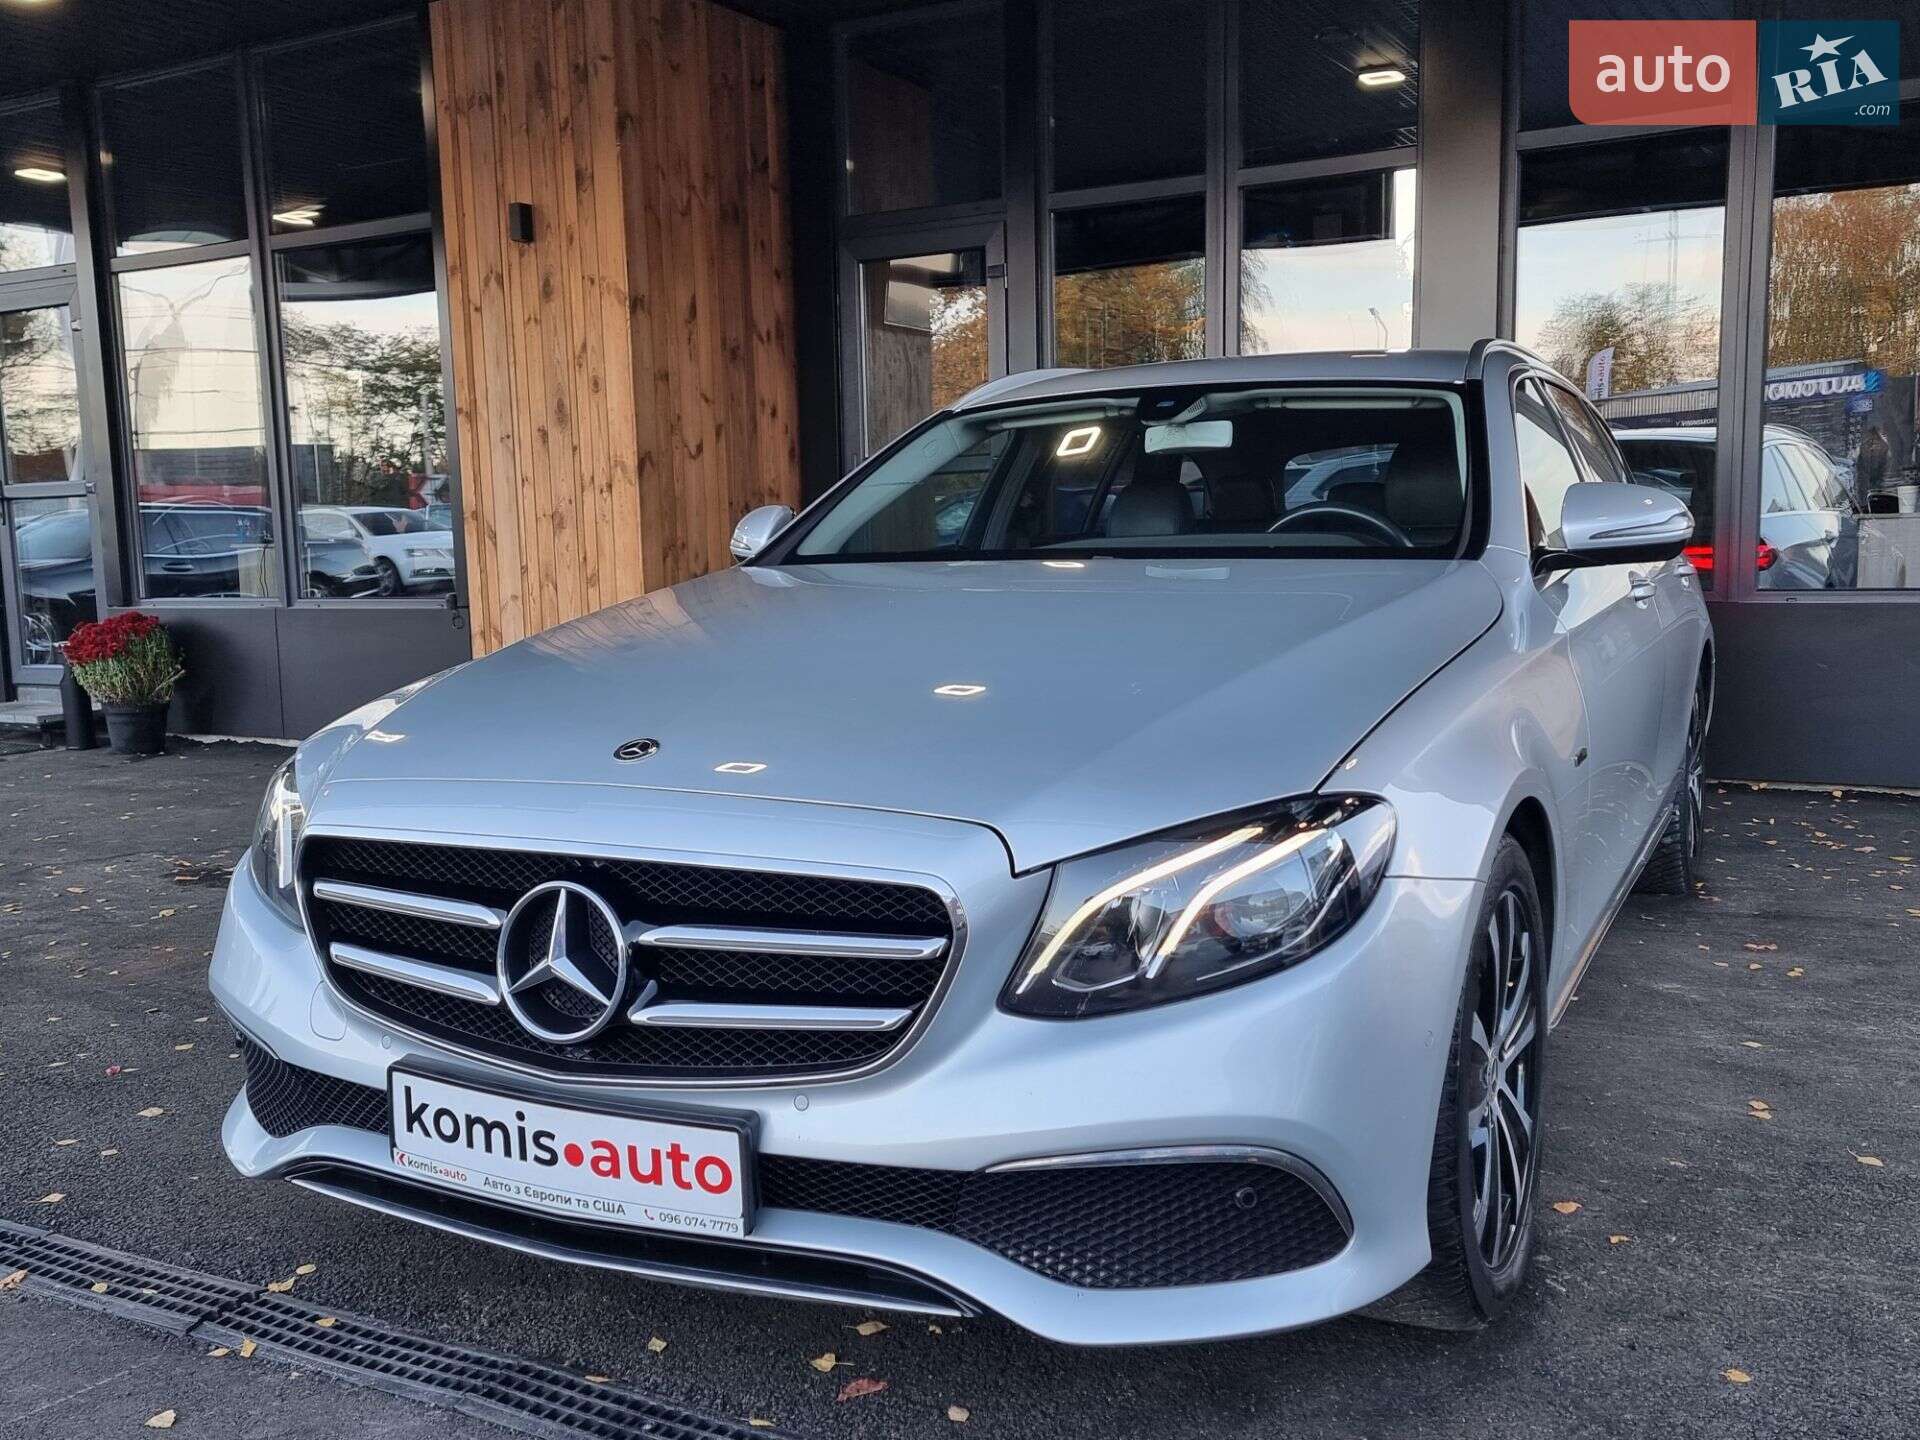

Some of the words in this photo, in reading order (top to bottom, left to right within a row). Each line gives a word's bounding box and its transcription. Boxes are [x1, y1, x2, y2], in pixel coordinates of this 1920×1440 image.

[483, 1176, 512, 1193] Авто
[524, 1185, 572, 1205] Європи
[574, 1197, 589, 1209] та
[593, 1199, 626, 1216] США
[659, 1211, 682, 1225] 096
[684, 1216, 707, 1229] 074
[709, 1219, 739, 1234] 7779
